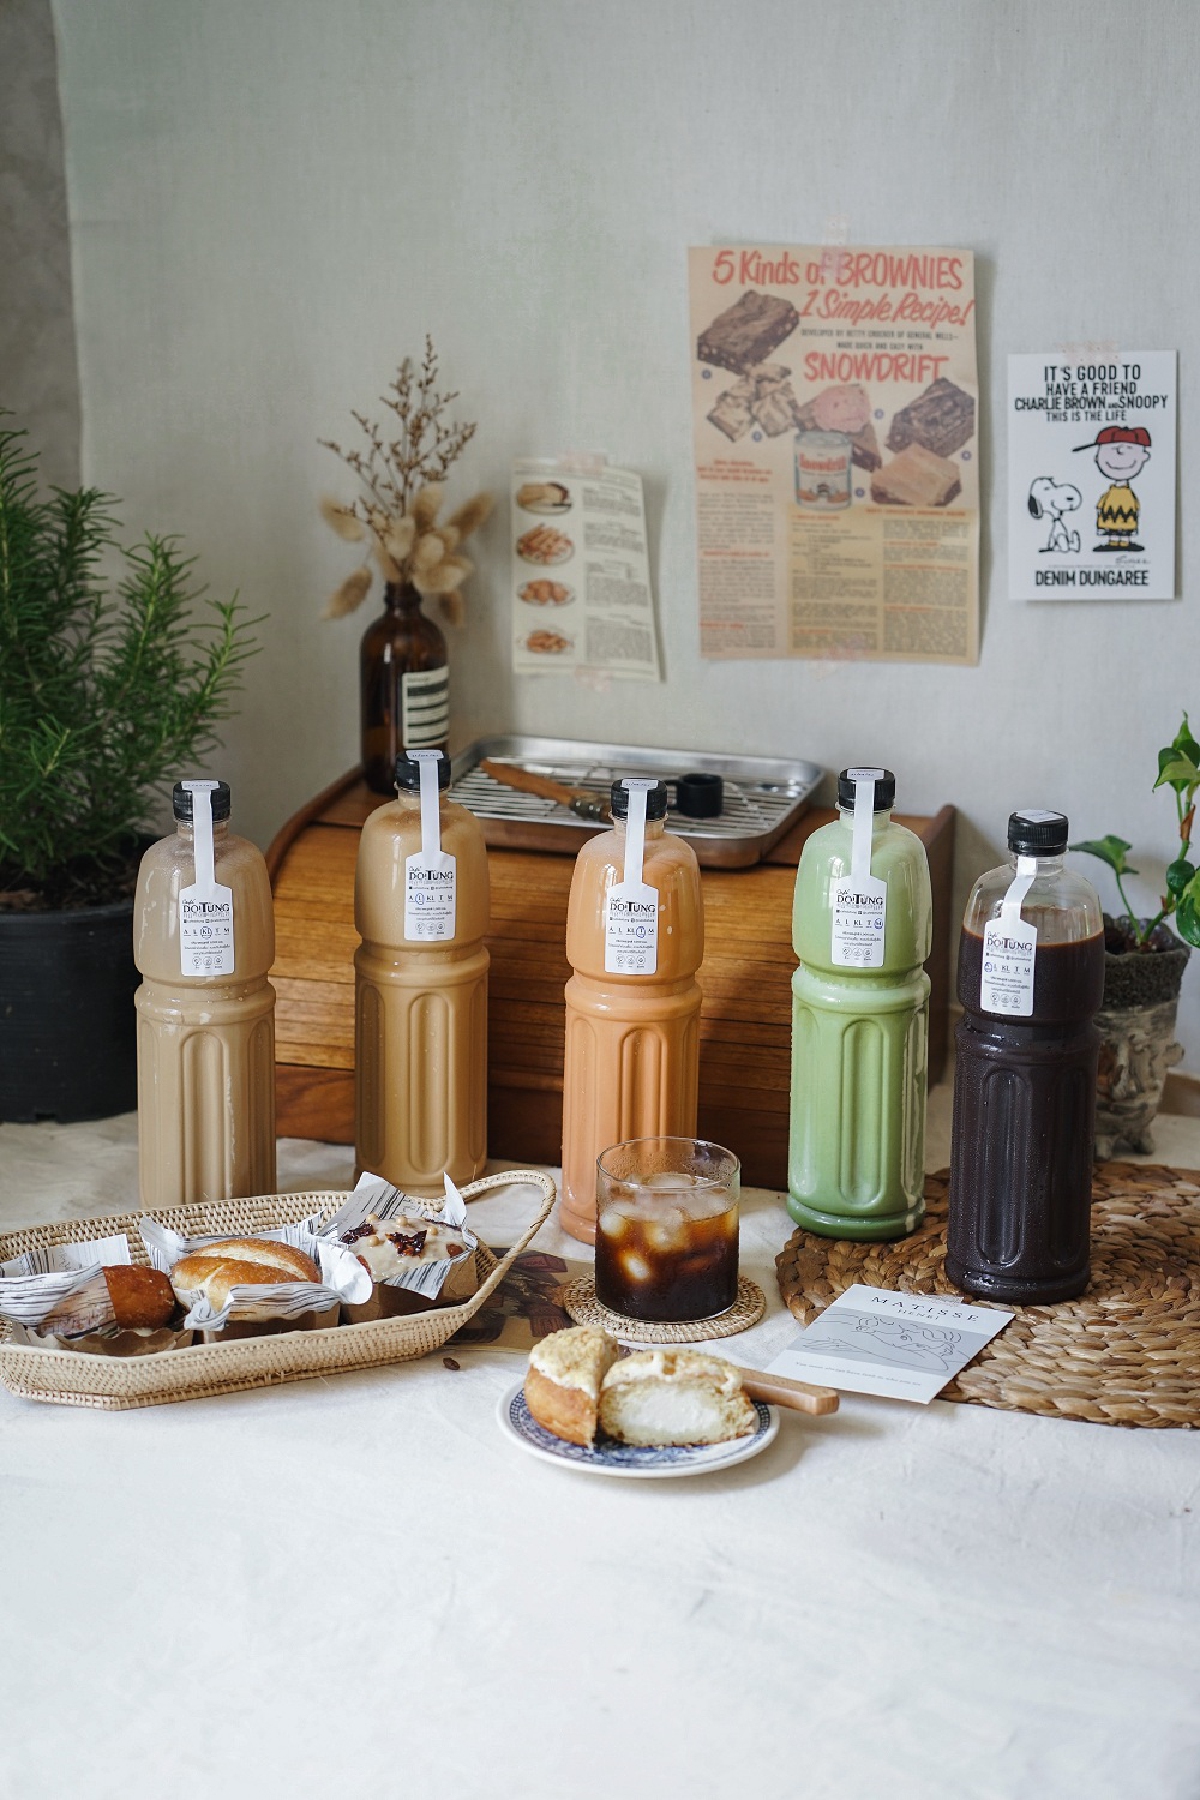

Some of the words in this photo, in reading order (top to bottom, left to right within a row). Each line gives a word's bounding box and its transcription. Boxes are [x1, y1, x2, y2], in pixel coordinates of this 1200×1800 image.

[712, 250, 734, 285] 5
[738, 251, 800, 285] Kinds
[805, 250, 834, 285] of
[836, 252, 963, 289] BROWNIES
[799, 289, 818, 318] 1
[816, 288, 893, 326] Simple
[892, 292, 976, 330] Recipe!
[804, 352, 950, 384] SNOWDRIFT
[1044, 366, 1071, 382] IT'S
[1078, 365, 1117, 381] GOOD
[1122, 364, 1141, 380] TO
[1046, 382, 1077, 396] HAVE
[1081, 382, 1088, 396] A
[1092, 382, 1137, 396] FRIEND
[1014, 396, 1062, 410] CHARLIE
[1064, 396, 1106, 410] BROWN
[1119, 394, 1168, 409] SNOOPY
[1046, 412, 1068, 422] THIS
[1072, 412, 1080, 422] IS
[1085, 412, 1101, 422] THE
[1106, 410, 1127, 422] LIFE
[1036, 570, 1076, 586] DENIM
[1080, 570, 1149, 586] DUNGAREE
[872, 1296, 979, 1321] MATISSE
